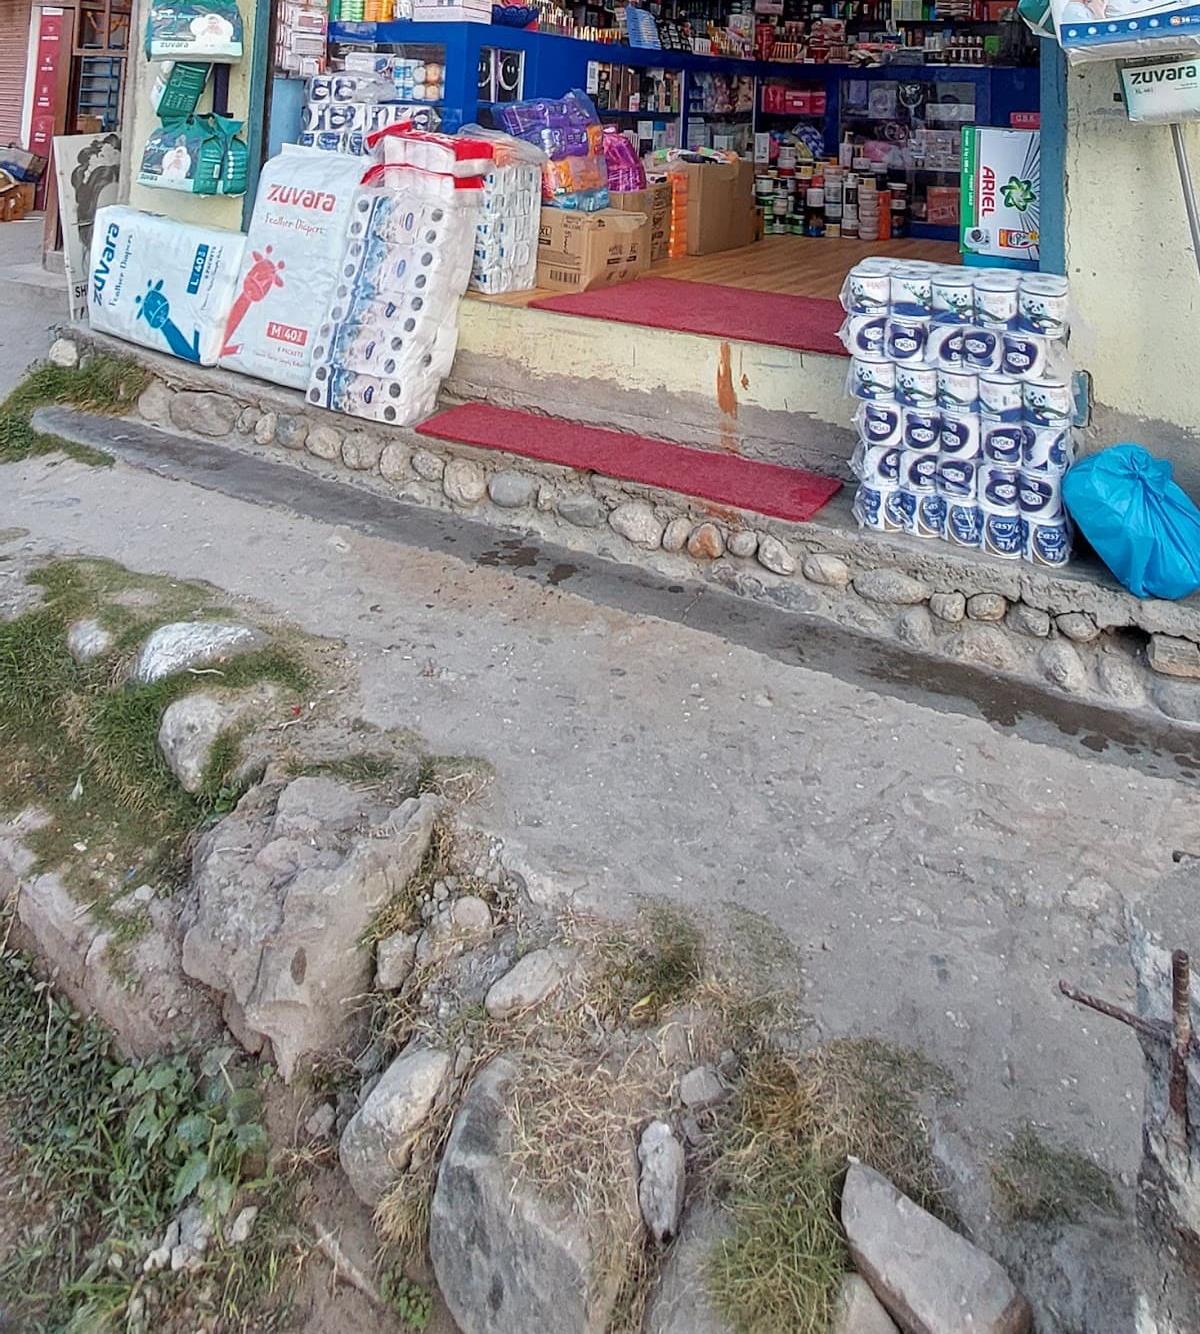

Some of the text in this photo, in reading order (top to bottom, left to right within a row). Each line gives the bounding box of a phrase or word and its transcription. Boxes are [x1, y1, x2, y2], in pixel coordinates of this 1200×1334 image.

[1130, 65, 1197, 85] zuvara
[266, 183, 336, 212] zuvara
[982, 166, 995, 217] ARIEL
[93, 222, 120, 307] zuvara
